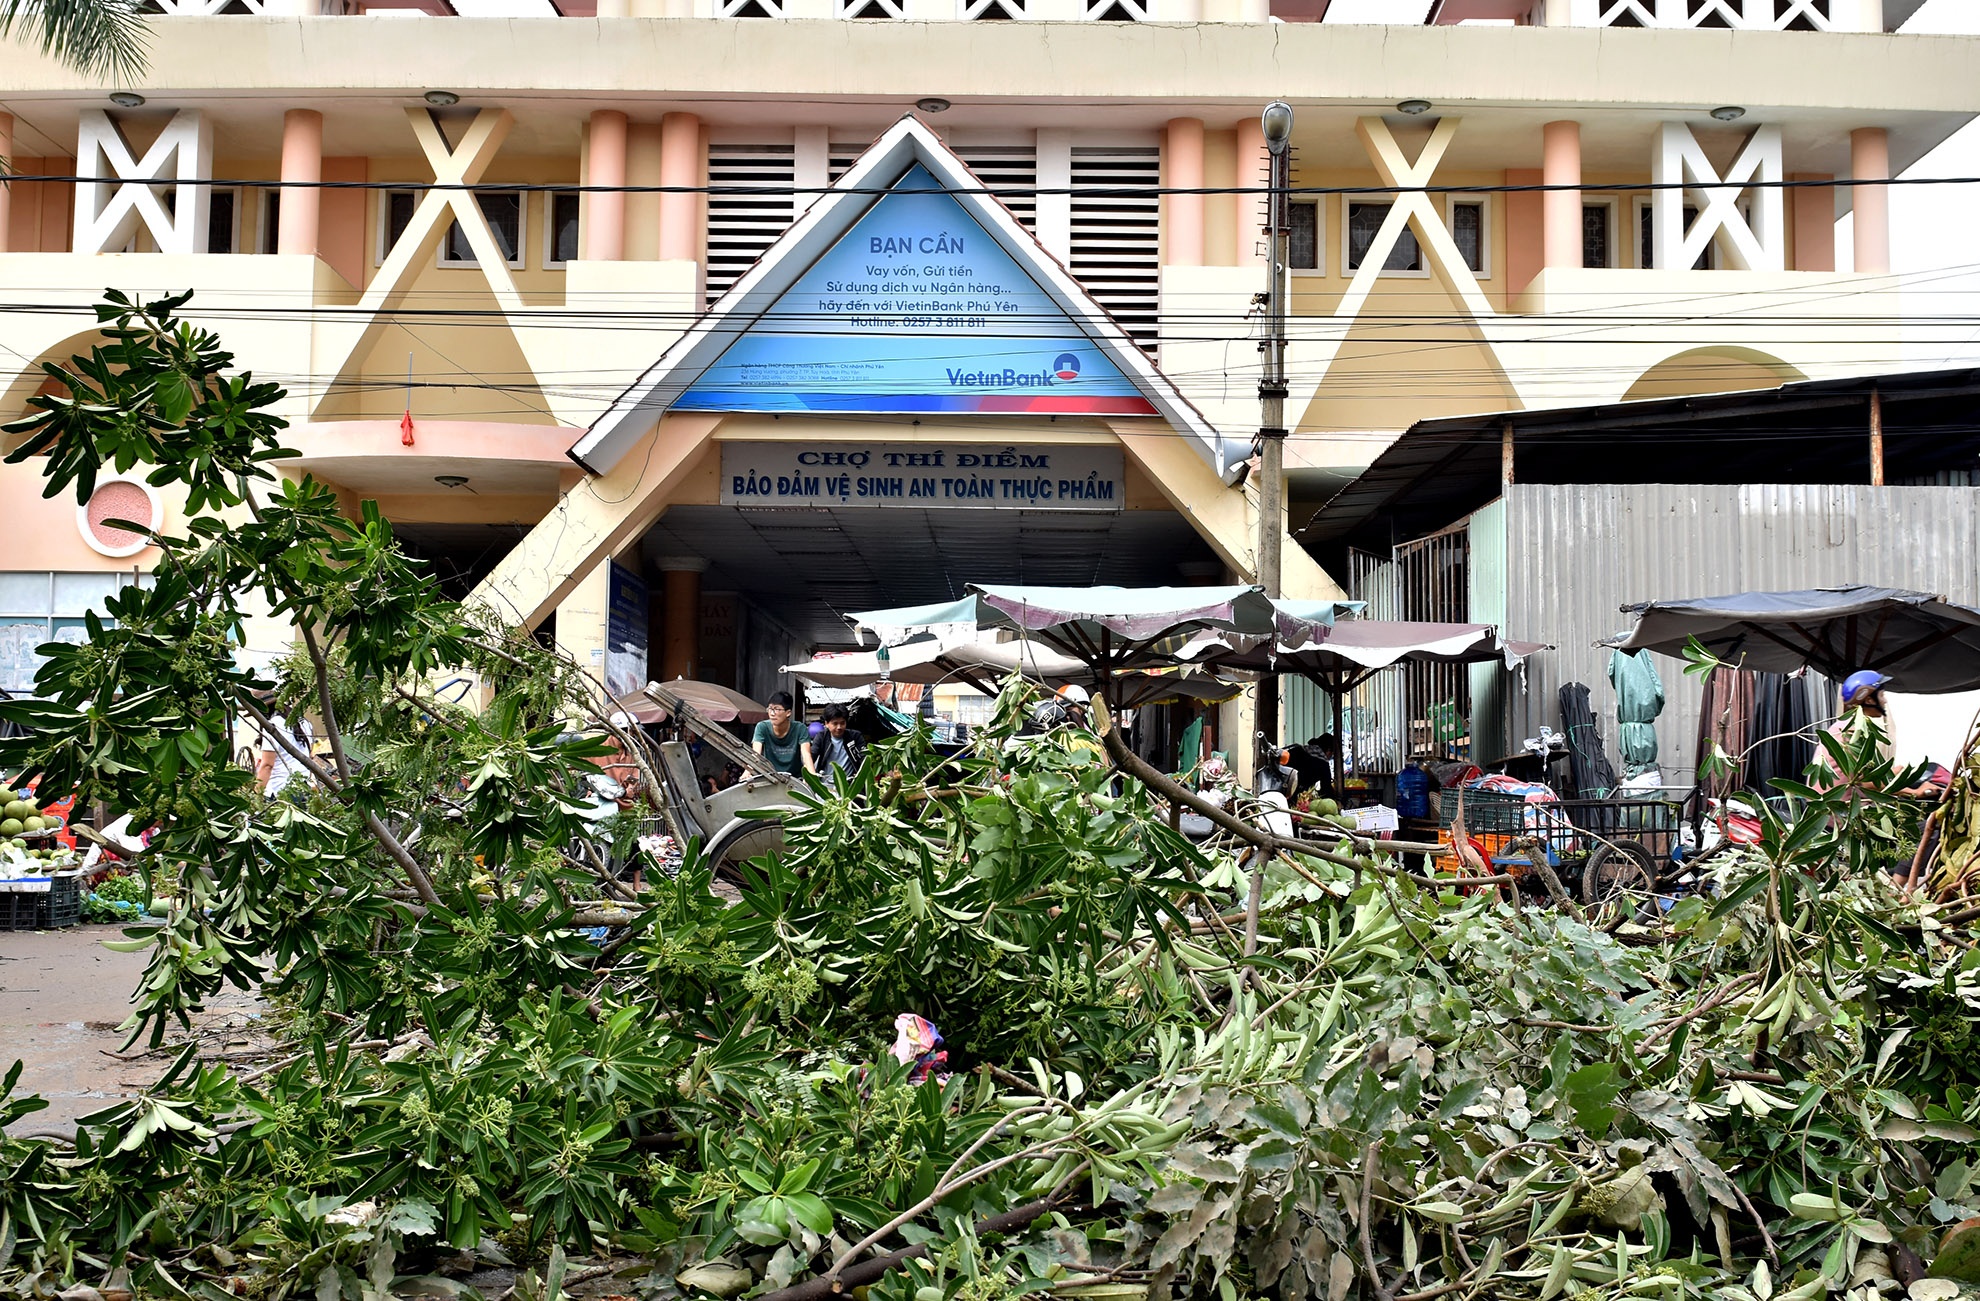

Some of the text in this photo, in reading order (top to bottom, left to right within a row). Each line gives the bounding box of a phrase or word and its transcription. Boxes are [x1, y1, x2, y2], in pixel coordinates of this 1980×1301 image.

[870, 231, 964, 258] BẠN CẦN
[866, 264, 972, 278] Vay vốn, Gửi tiền
[826, 281, 1011, 296] Sử dụng dịch vụ Ngân hàng...
[818, 299, 1018, 313] hãy đến với VietinBank Phú Yên
[902, 317, 931, 327] 0257
[946, 368, 1055, 387] VietinBank
[798, 446, 1049, 469] CHỢ THÍ ĐIỂM
[733, 468, 1113, 503] BẢO ĐẢM VỆ SINH AN TOÀN THỰC PHẨM
